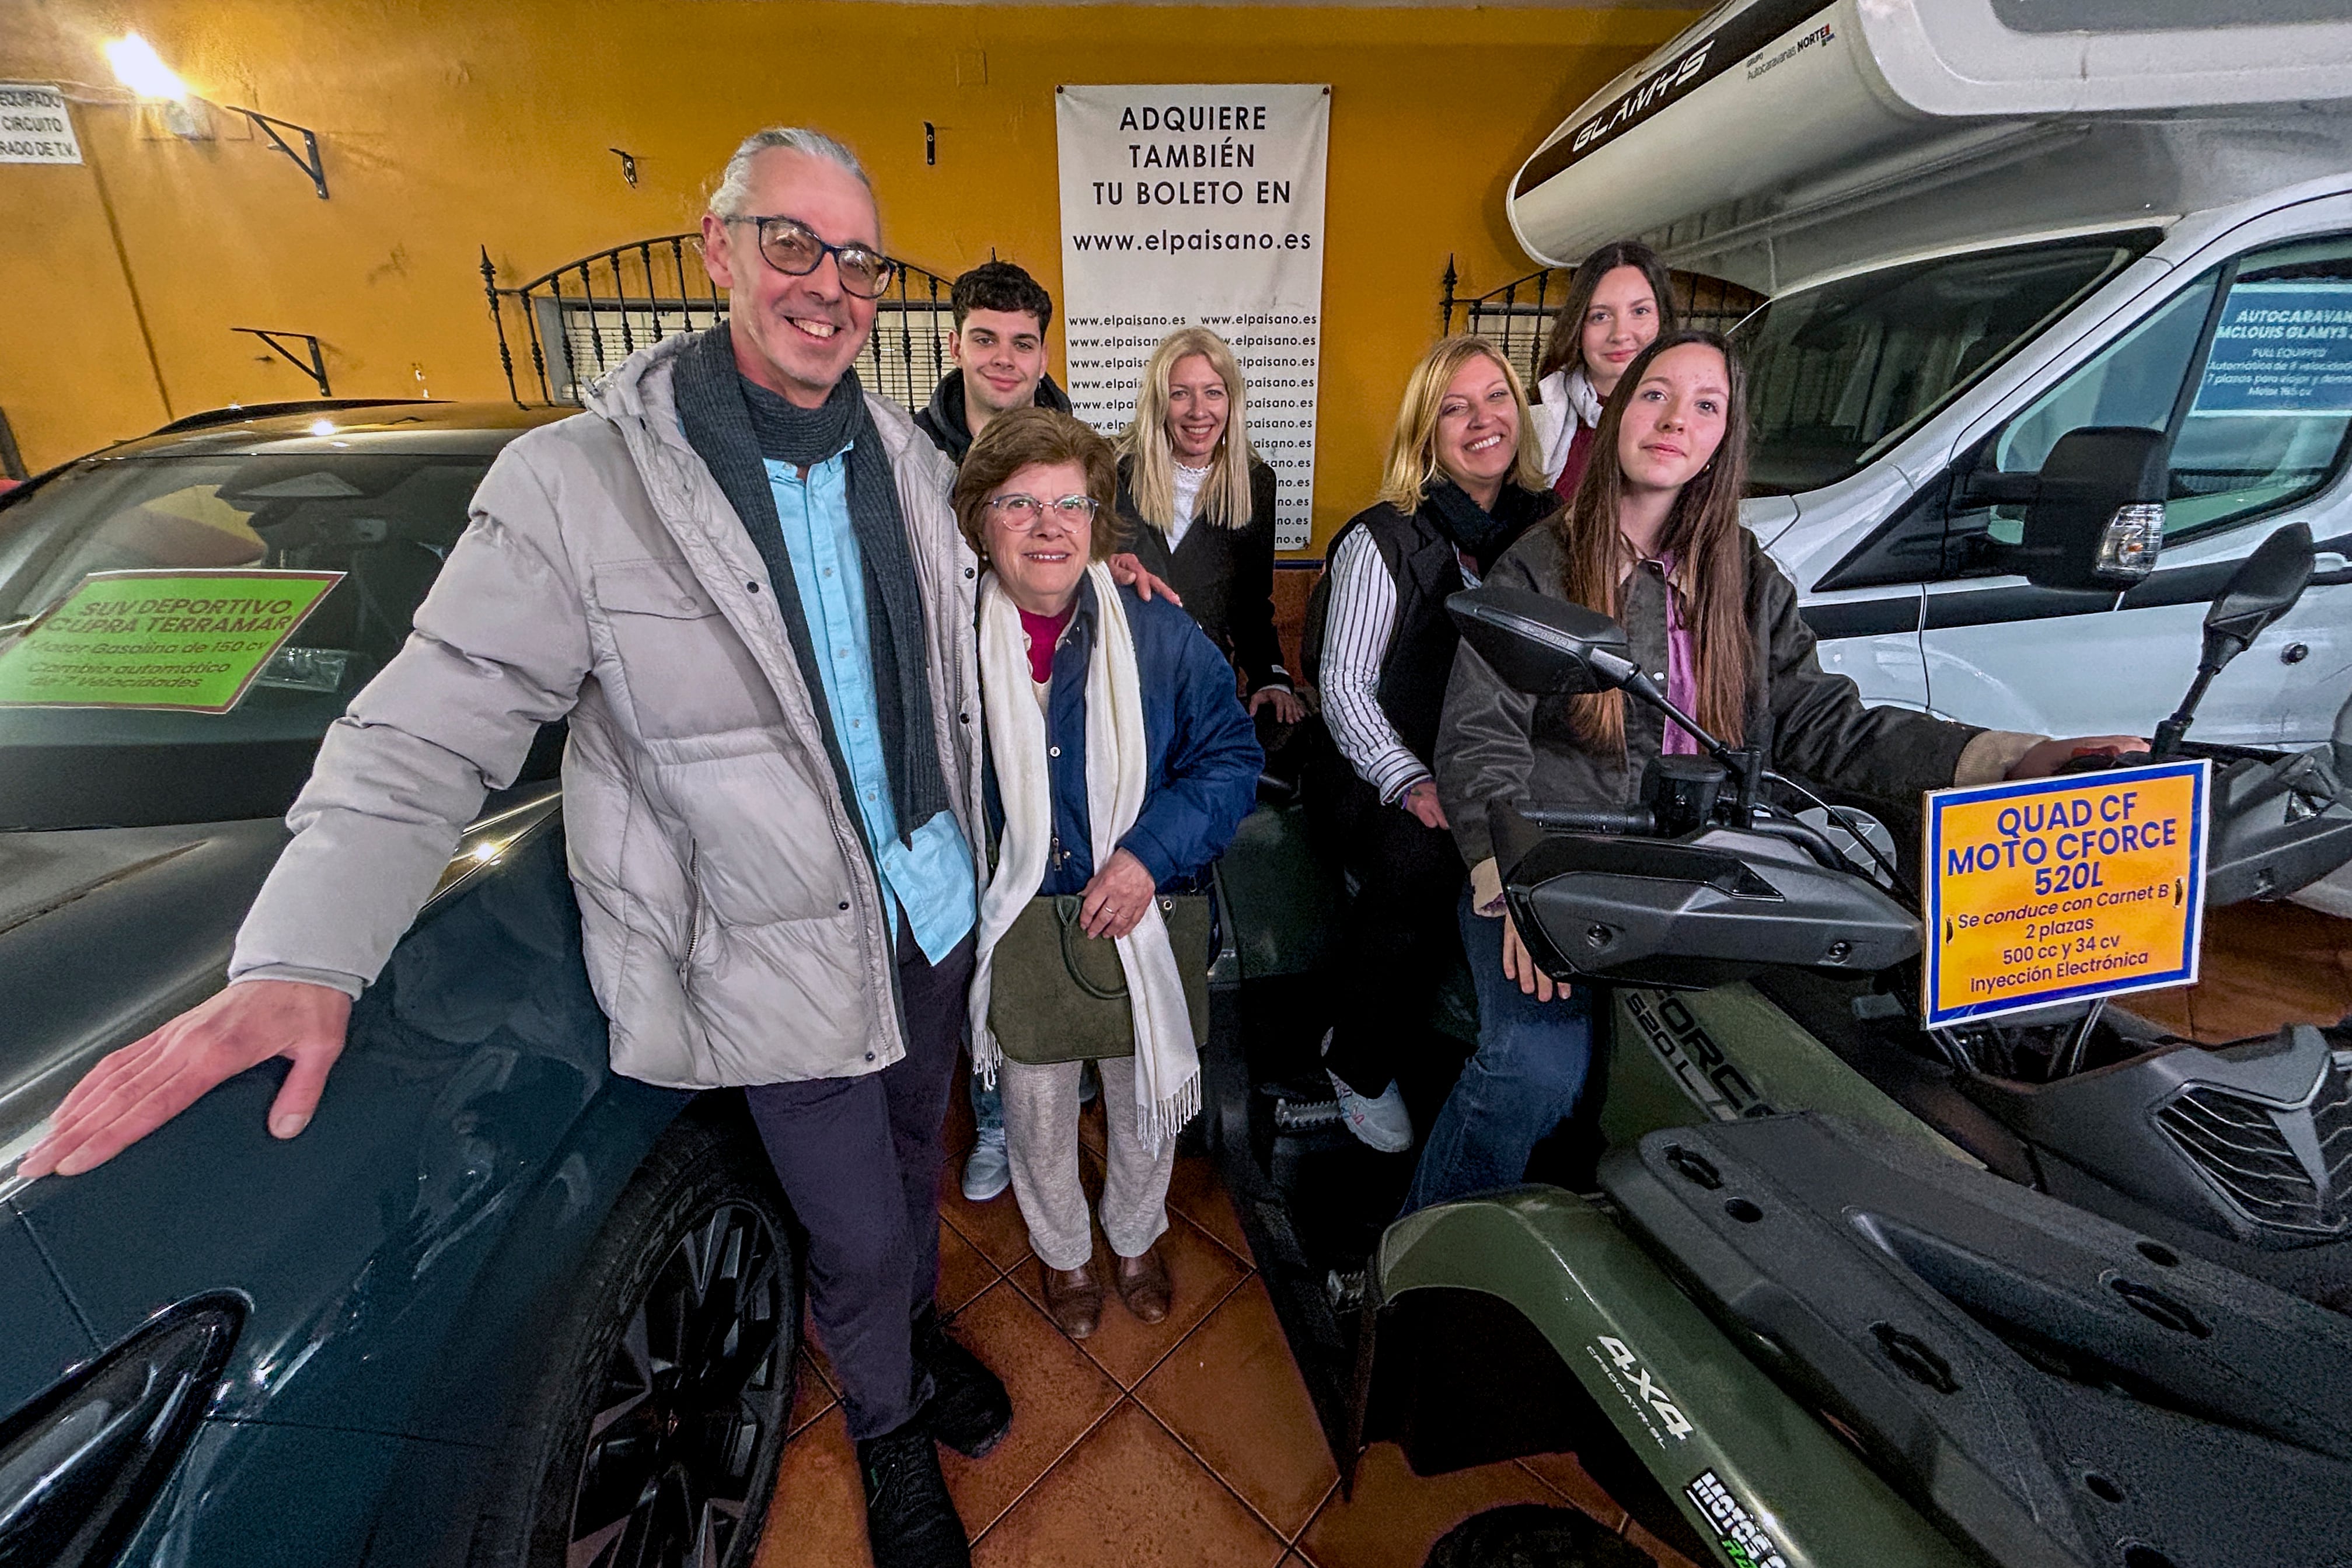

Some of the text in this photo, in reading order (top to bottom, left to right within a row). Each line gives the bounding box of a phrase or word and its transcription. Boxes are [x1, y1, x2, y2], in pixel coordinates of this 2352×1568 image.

[1797, 27, 1826, 53] NORTE
[1573, 40, 1715, 152] GLAMYS
[2, 116, 62, 132] CIRCUITO
[1119, 106, 1266, 132] ADQUIERE
[34, 141, 54, 156] DE
[1129, 137, 1255, 168] TAMBIÉN
[1093, 180, 1290, 205] TU BOLETO EN
[1073, 229, 1311, 254] www.elpaisano.es
[1069, 313, 1317, 327] www.elpaisano.es www.elpaisano.es
[2217, 326, 2285, 338] MCLOUIS
[2286, 326, 2348, 338] GLAMYS
[79, 598, 292, 616] SUV DEPORTIVO
[46, 615, 293, 633] CUPRA TERRAMAR
[91, 642, 178, 654] Gasolina
[182, 642, 208, 653] de
[211, 641, 243, 652] 150
[246, 641, 269, 651] cv
[114, 662, 231, 674] automático
[77, 676, 203, 687] Velocidades
[1997, 791, 2138, 839] QUAD CF
[1948, 818, 2176, 876] MOTO CFORCE
[2035, 861, 2104, 896] 520L
[1958, 883, 2170, 930] Se conduce con Carnet B
[2025, 917, 2095, 942] 2 plazas
[2002, 935, 2120, 966] 500 cc y 34 cv
[1970, 950, 2149, 995] Inyección Electrónica
[1657, 995, 1770, 1116] ORC
[1597, 1335, 1693, 1441] 4X4
[1692, 1471, 1769, 1560] MOTOS
